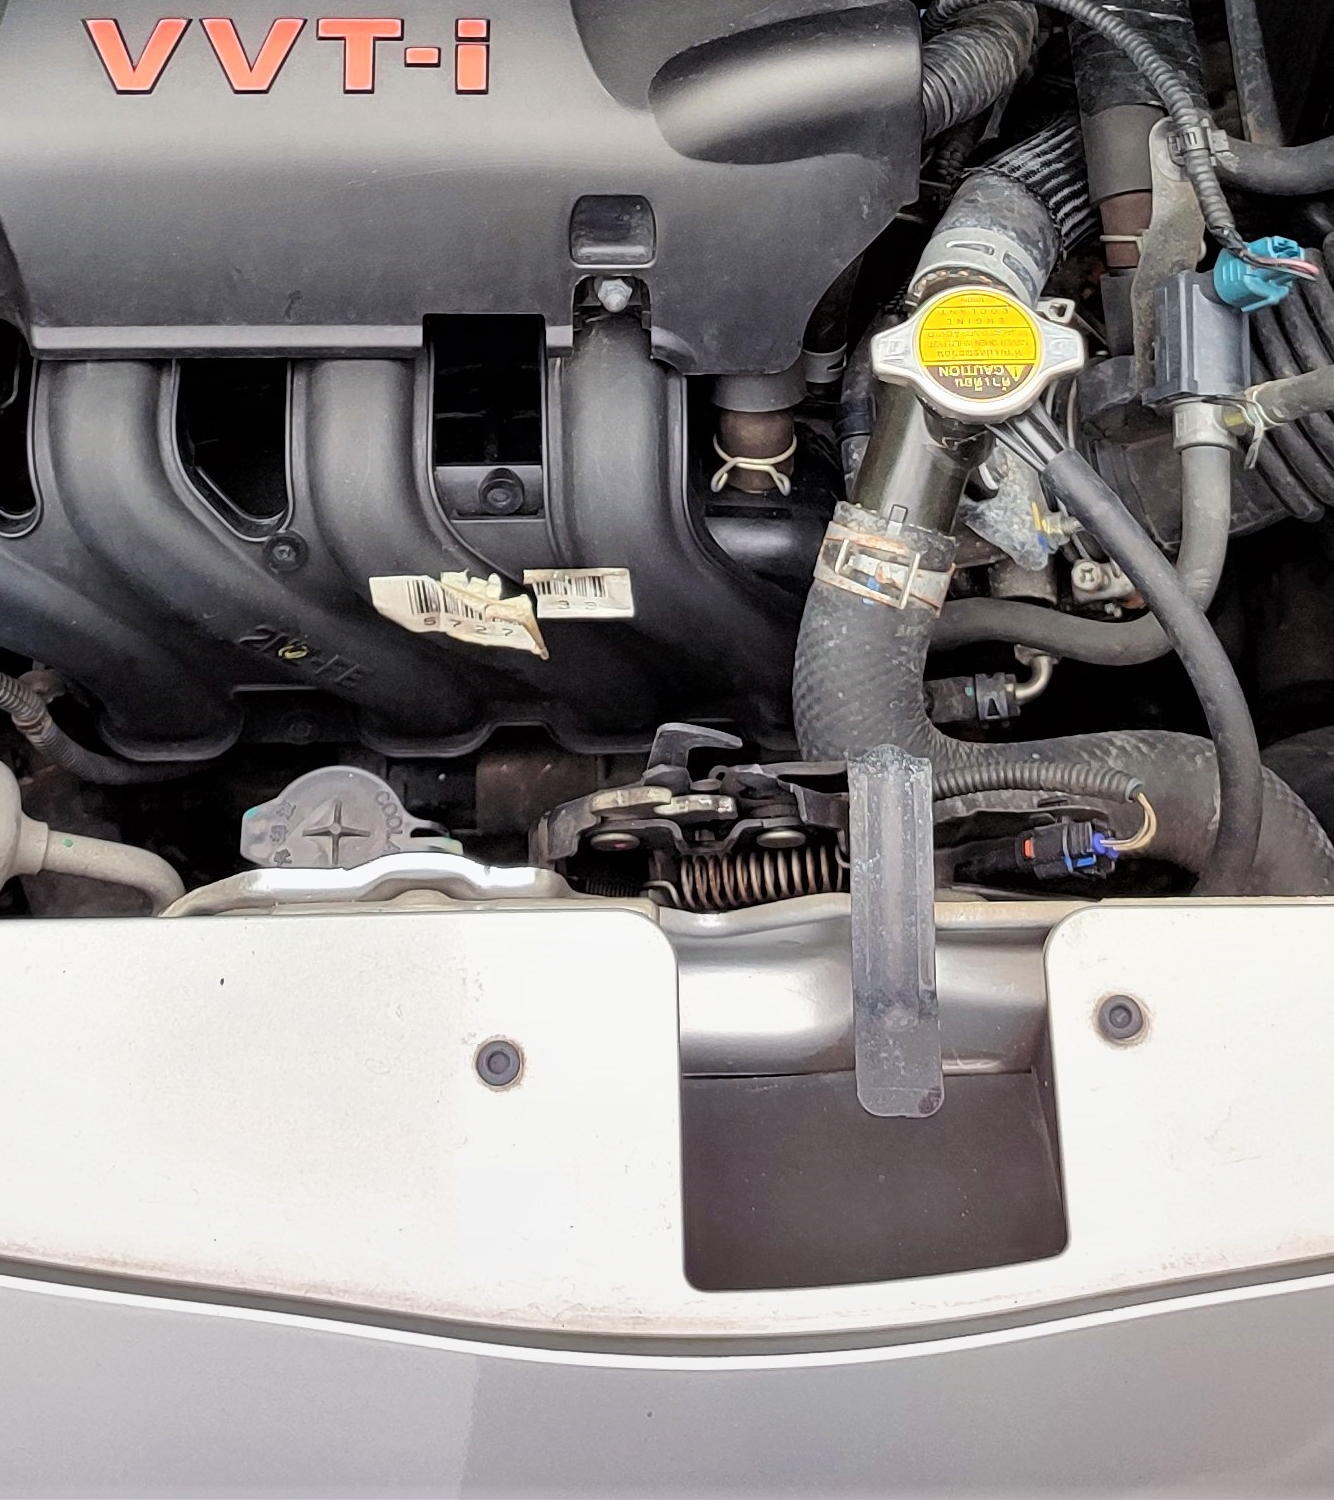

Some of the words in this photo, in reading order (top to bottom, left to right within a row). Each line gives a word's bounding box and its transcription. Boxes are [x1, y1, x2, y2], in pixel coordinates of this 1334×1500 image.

[82, 17, 491, 95] VVT-i
[938, 307, 1009, 316] COOLANT
[946, 317, 1005, 325] ENGINE
[938, 364, 1005, 377] CAUTION
